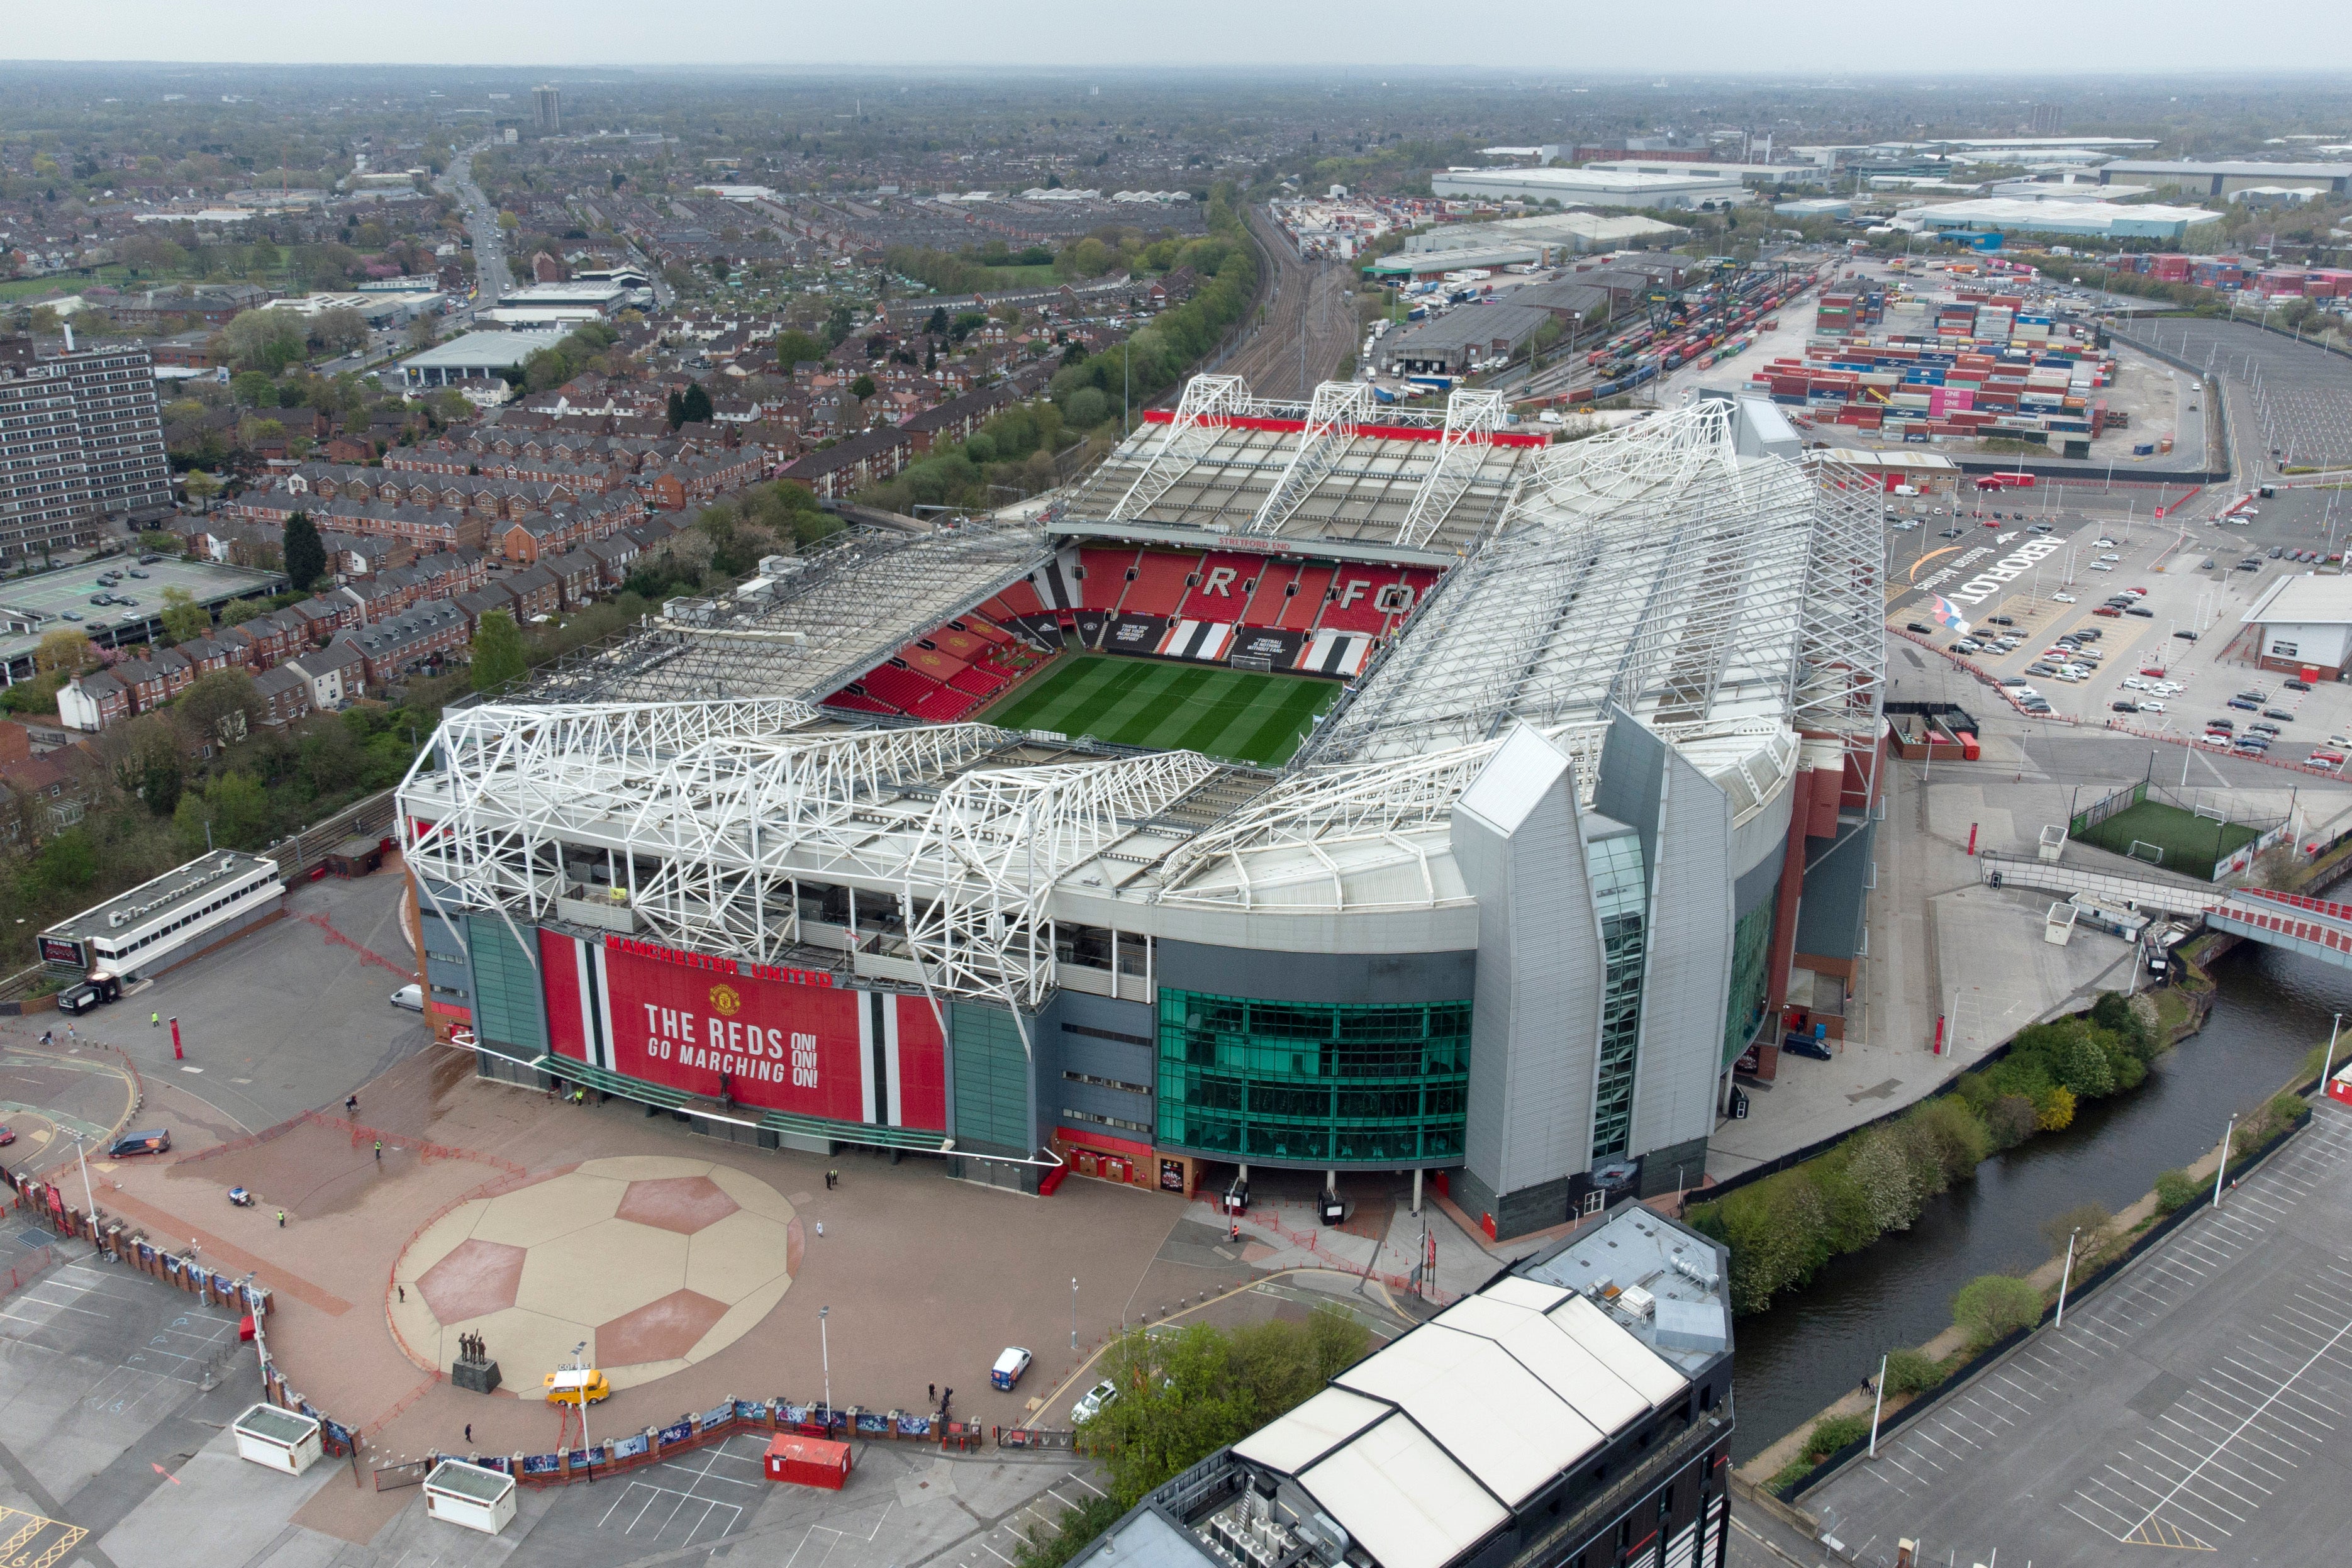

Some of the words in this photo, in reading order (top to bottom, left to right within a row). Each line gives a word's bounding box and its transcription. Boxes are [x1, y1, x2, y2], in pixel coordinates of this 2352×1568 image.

[1219, 537, 1268, 548] STRETFORD
[1272, 542, 1290, 550] END
[1948, 534, 2067, 605] AEROFLOT
[1950, 547, 1995, 568] Russian
[1914, 567, 1961, 591] Airlines
[606, 935, 738, 975] MANCHESTER
[752, 963, 833, 988] UNITED
[644, 1003, 696, 1043] THE
[708, 1017, 784, 1060] REDS
[791, 1031, 817, 1052] ON!
[648, 1037, 671, 1060] GO
[679, 1044, 784, 1083] MARCHING
[792, 1050, 817, 1069] ON!
[793, 1067, 818, 1089] ON!
